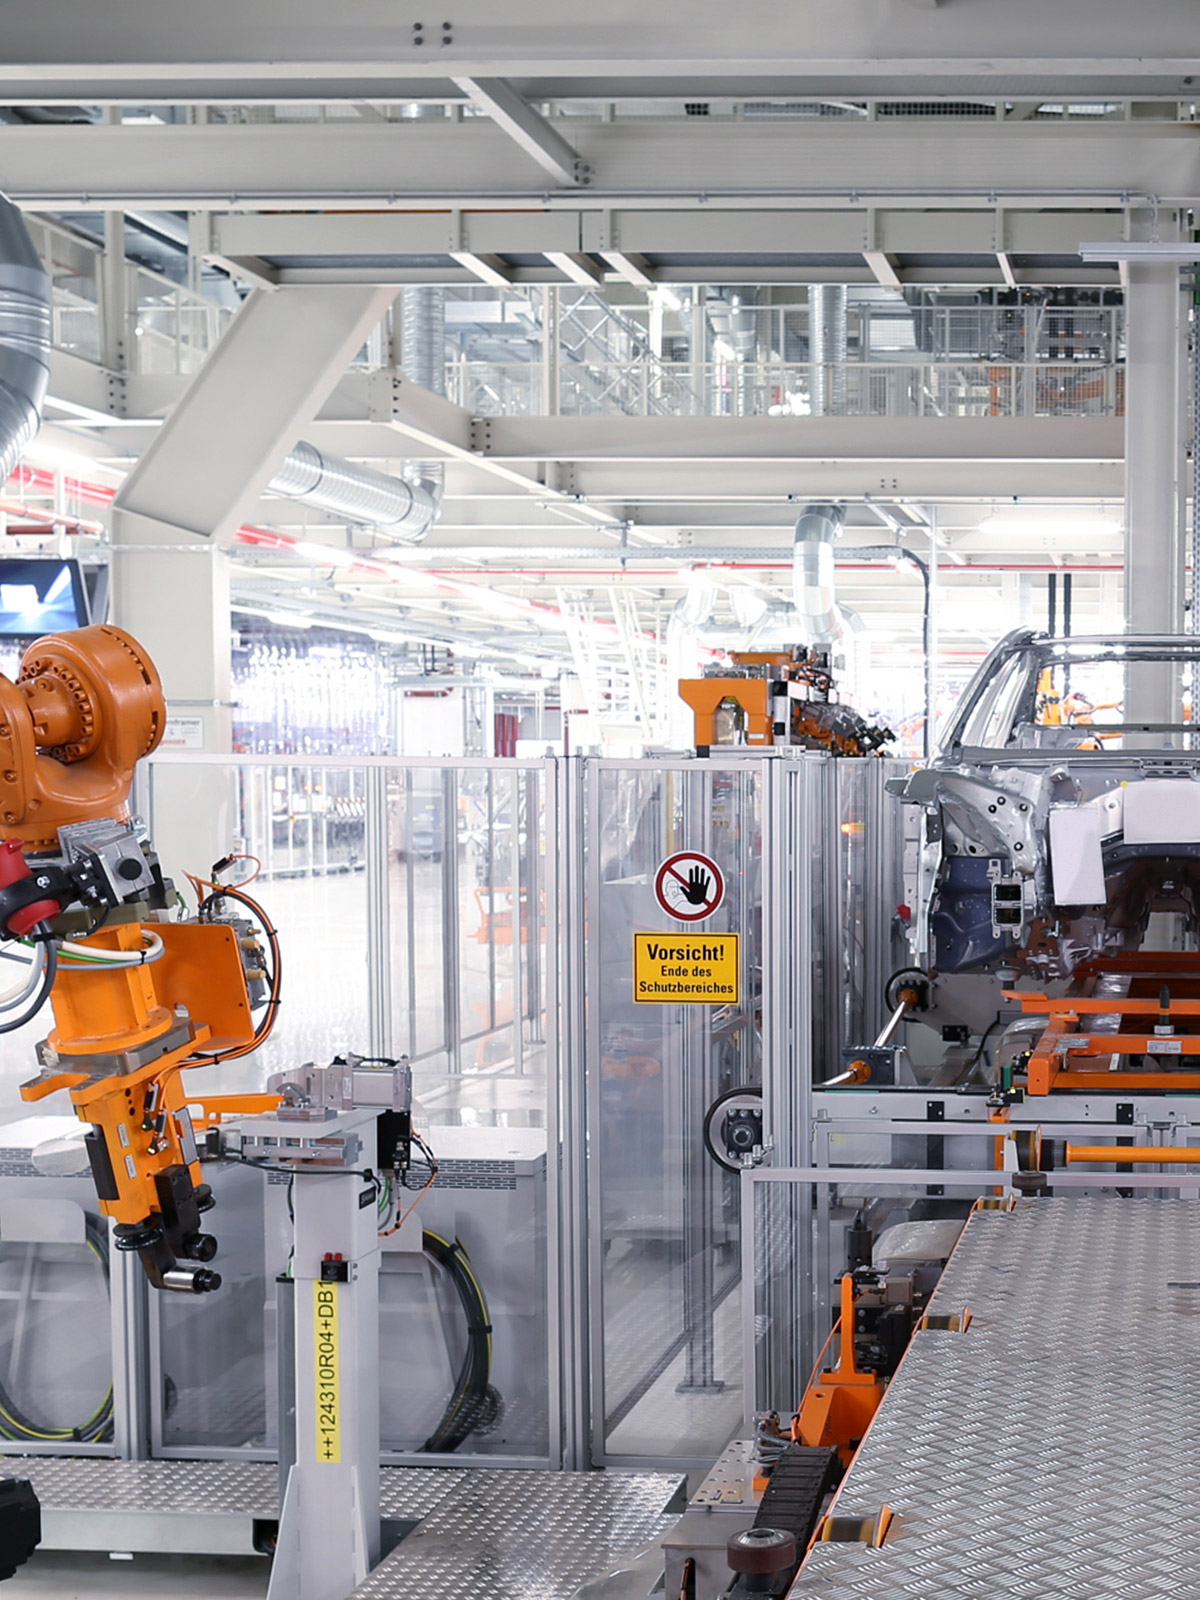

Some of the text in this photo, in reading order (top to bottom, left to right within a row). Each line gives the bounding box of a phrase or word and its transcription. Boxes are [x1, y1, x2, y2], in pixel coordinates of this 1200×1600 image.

[647, 943, 724, 961] Vorsicht!
[661, 965, 712, 977] Ende des
[639, 980, 734, 994] Schutzbereiches
[317, 1280, 336, 1460] ++124310R04+DB1
